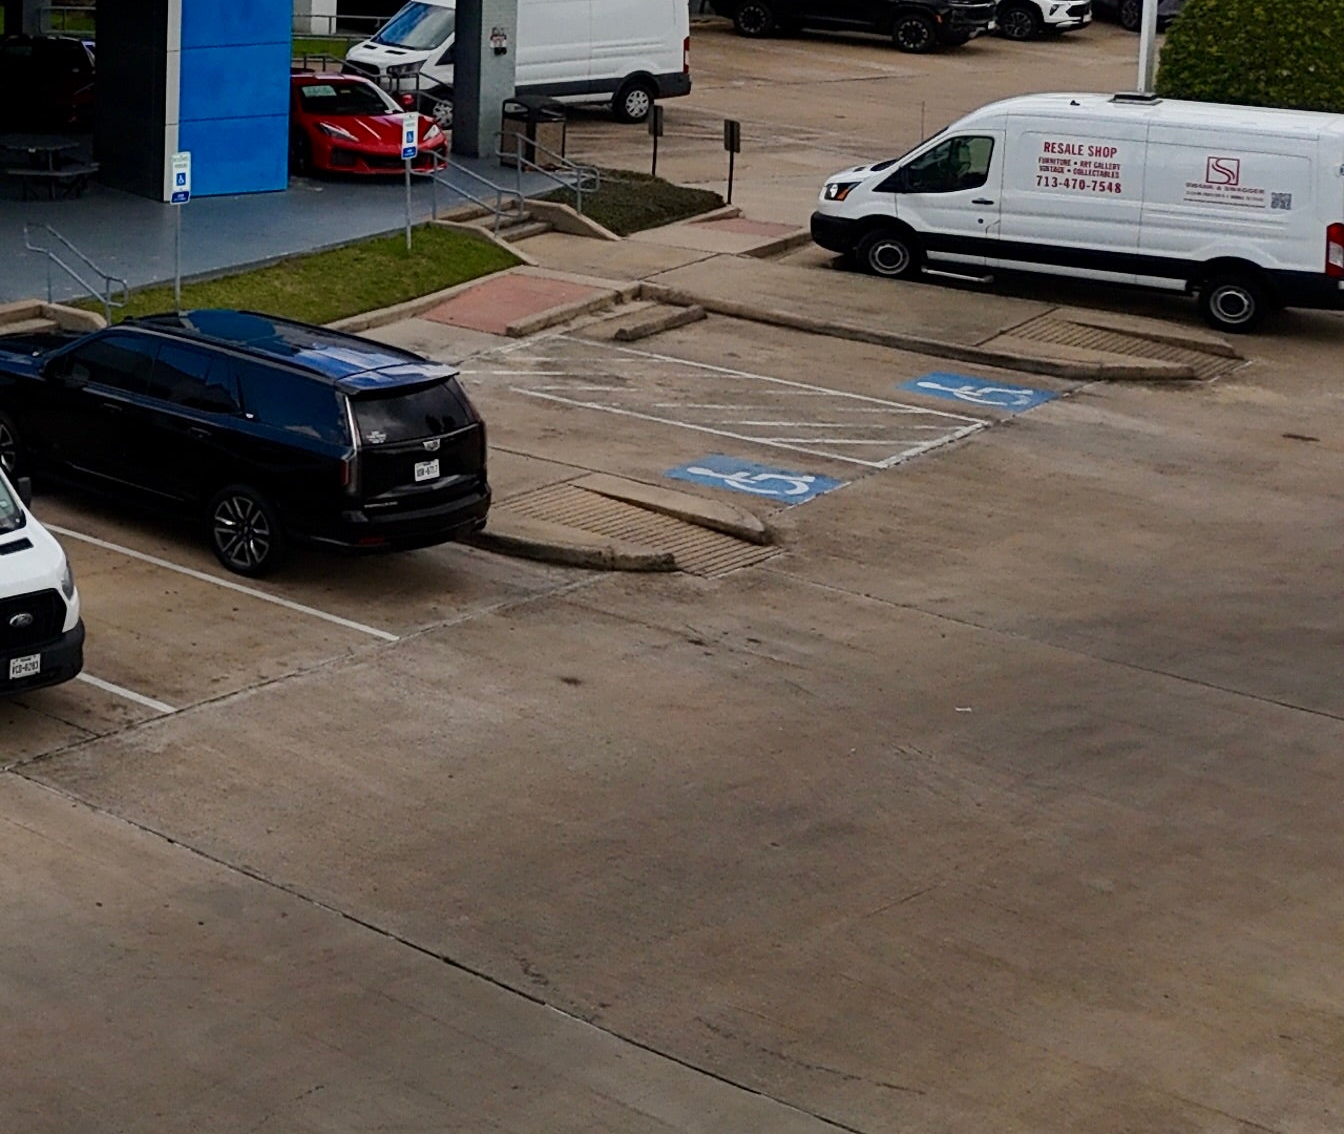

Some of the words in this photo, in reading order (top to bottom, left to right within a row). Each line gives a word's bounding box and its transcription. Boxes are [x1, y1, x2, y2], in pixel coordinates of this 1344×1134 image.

[1043, 141, 1084, 155] RESALE
[1087, 145, 1118, 158] SHOP
[1036, 175, 1122, 194] 713-470-7548
